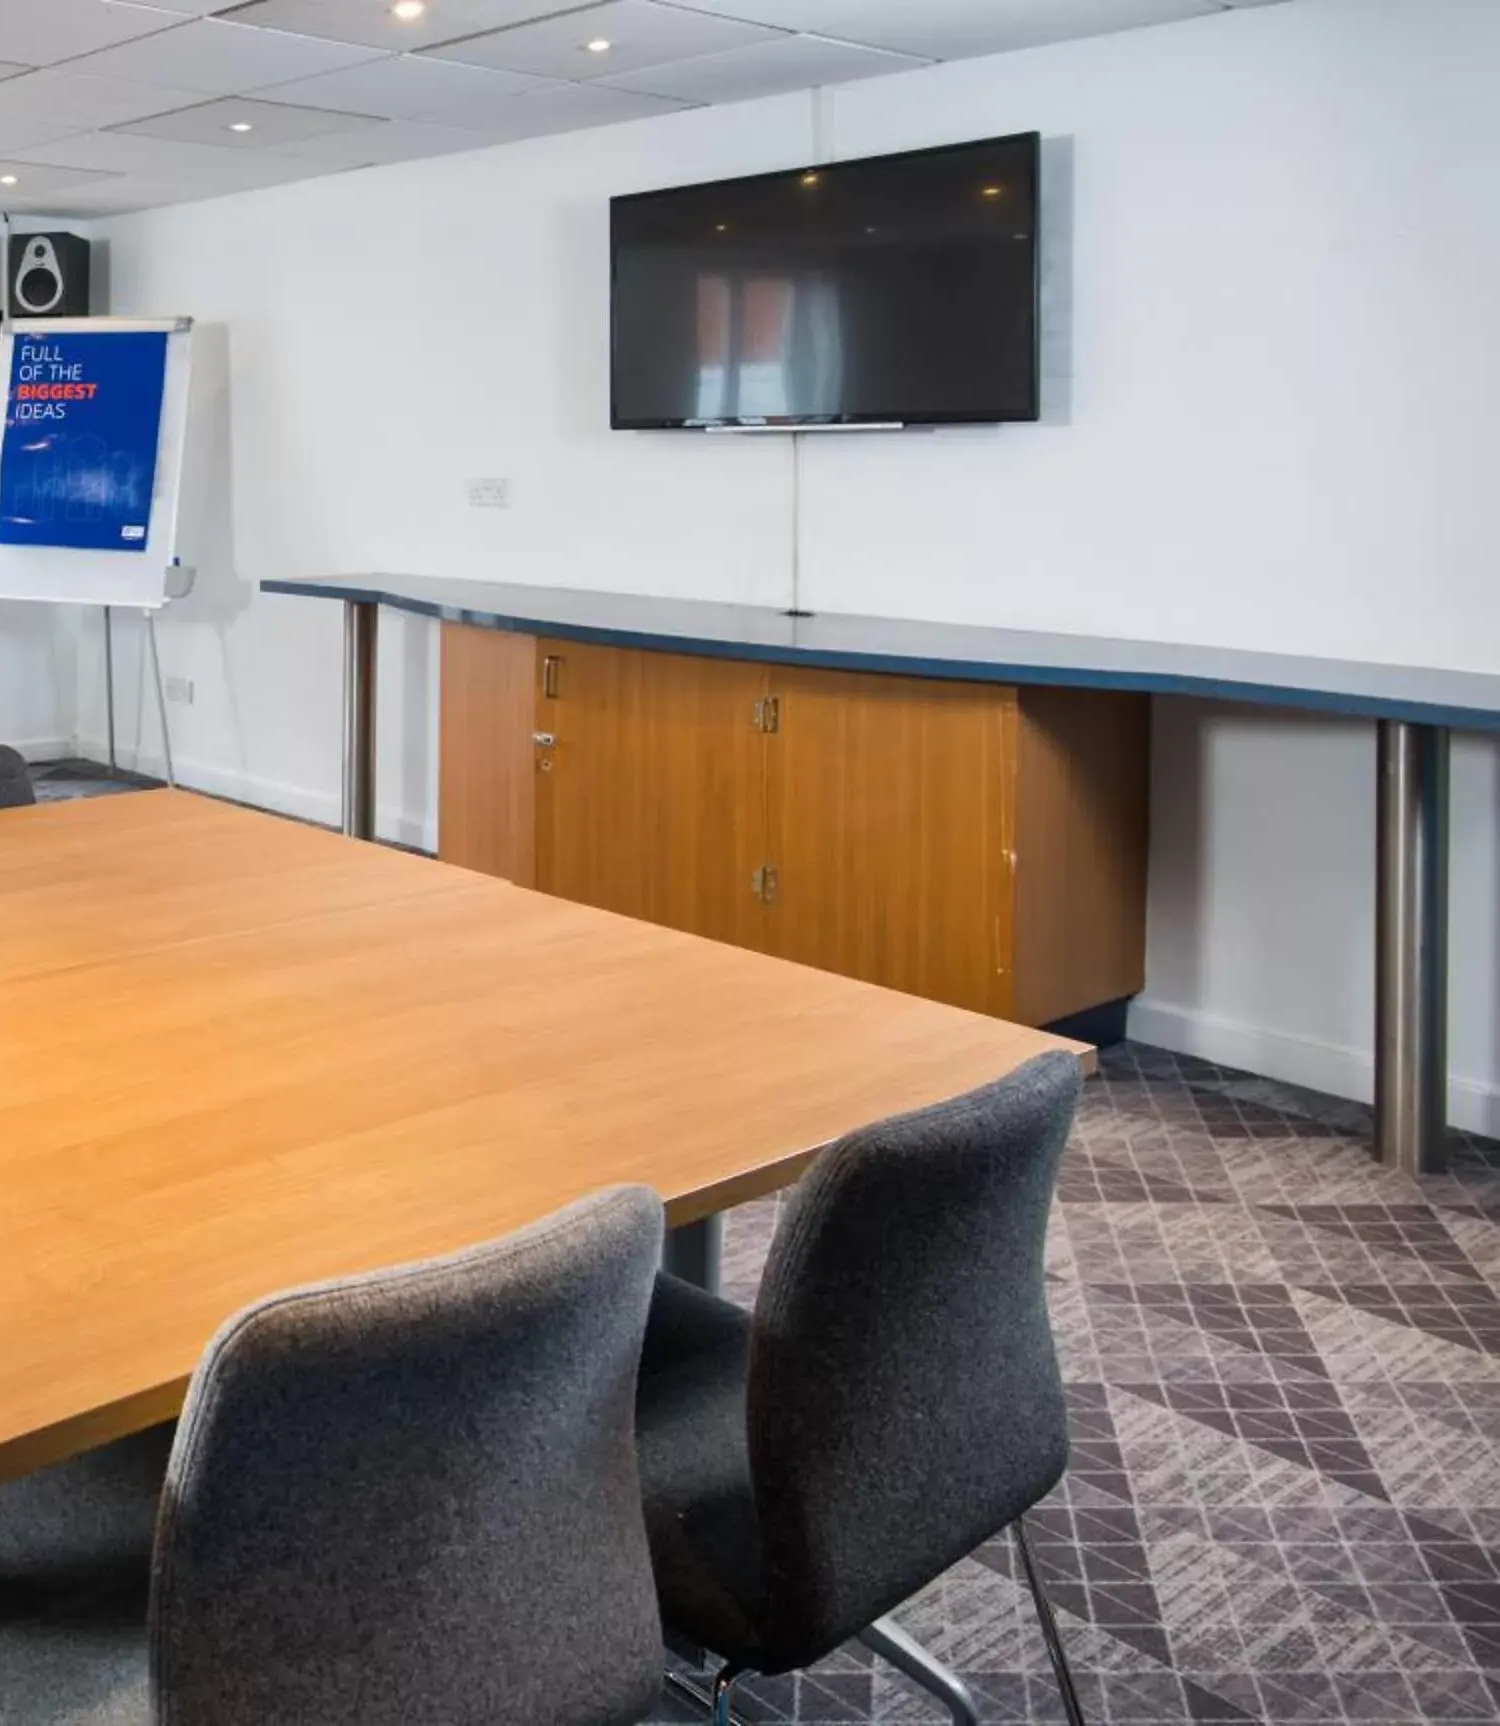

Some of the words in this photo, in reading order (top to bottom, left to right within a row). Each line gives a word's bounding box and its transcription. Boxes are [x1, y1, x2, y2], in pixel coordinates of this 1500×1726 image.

[21, 345, 63, 362] FULL
[19, 365, 43, 381] OF
[49, 363, 83, 381] THE
[17, 383, 97, 400] BIGGEST
[15, 403, 67, 420] IDEAS
